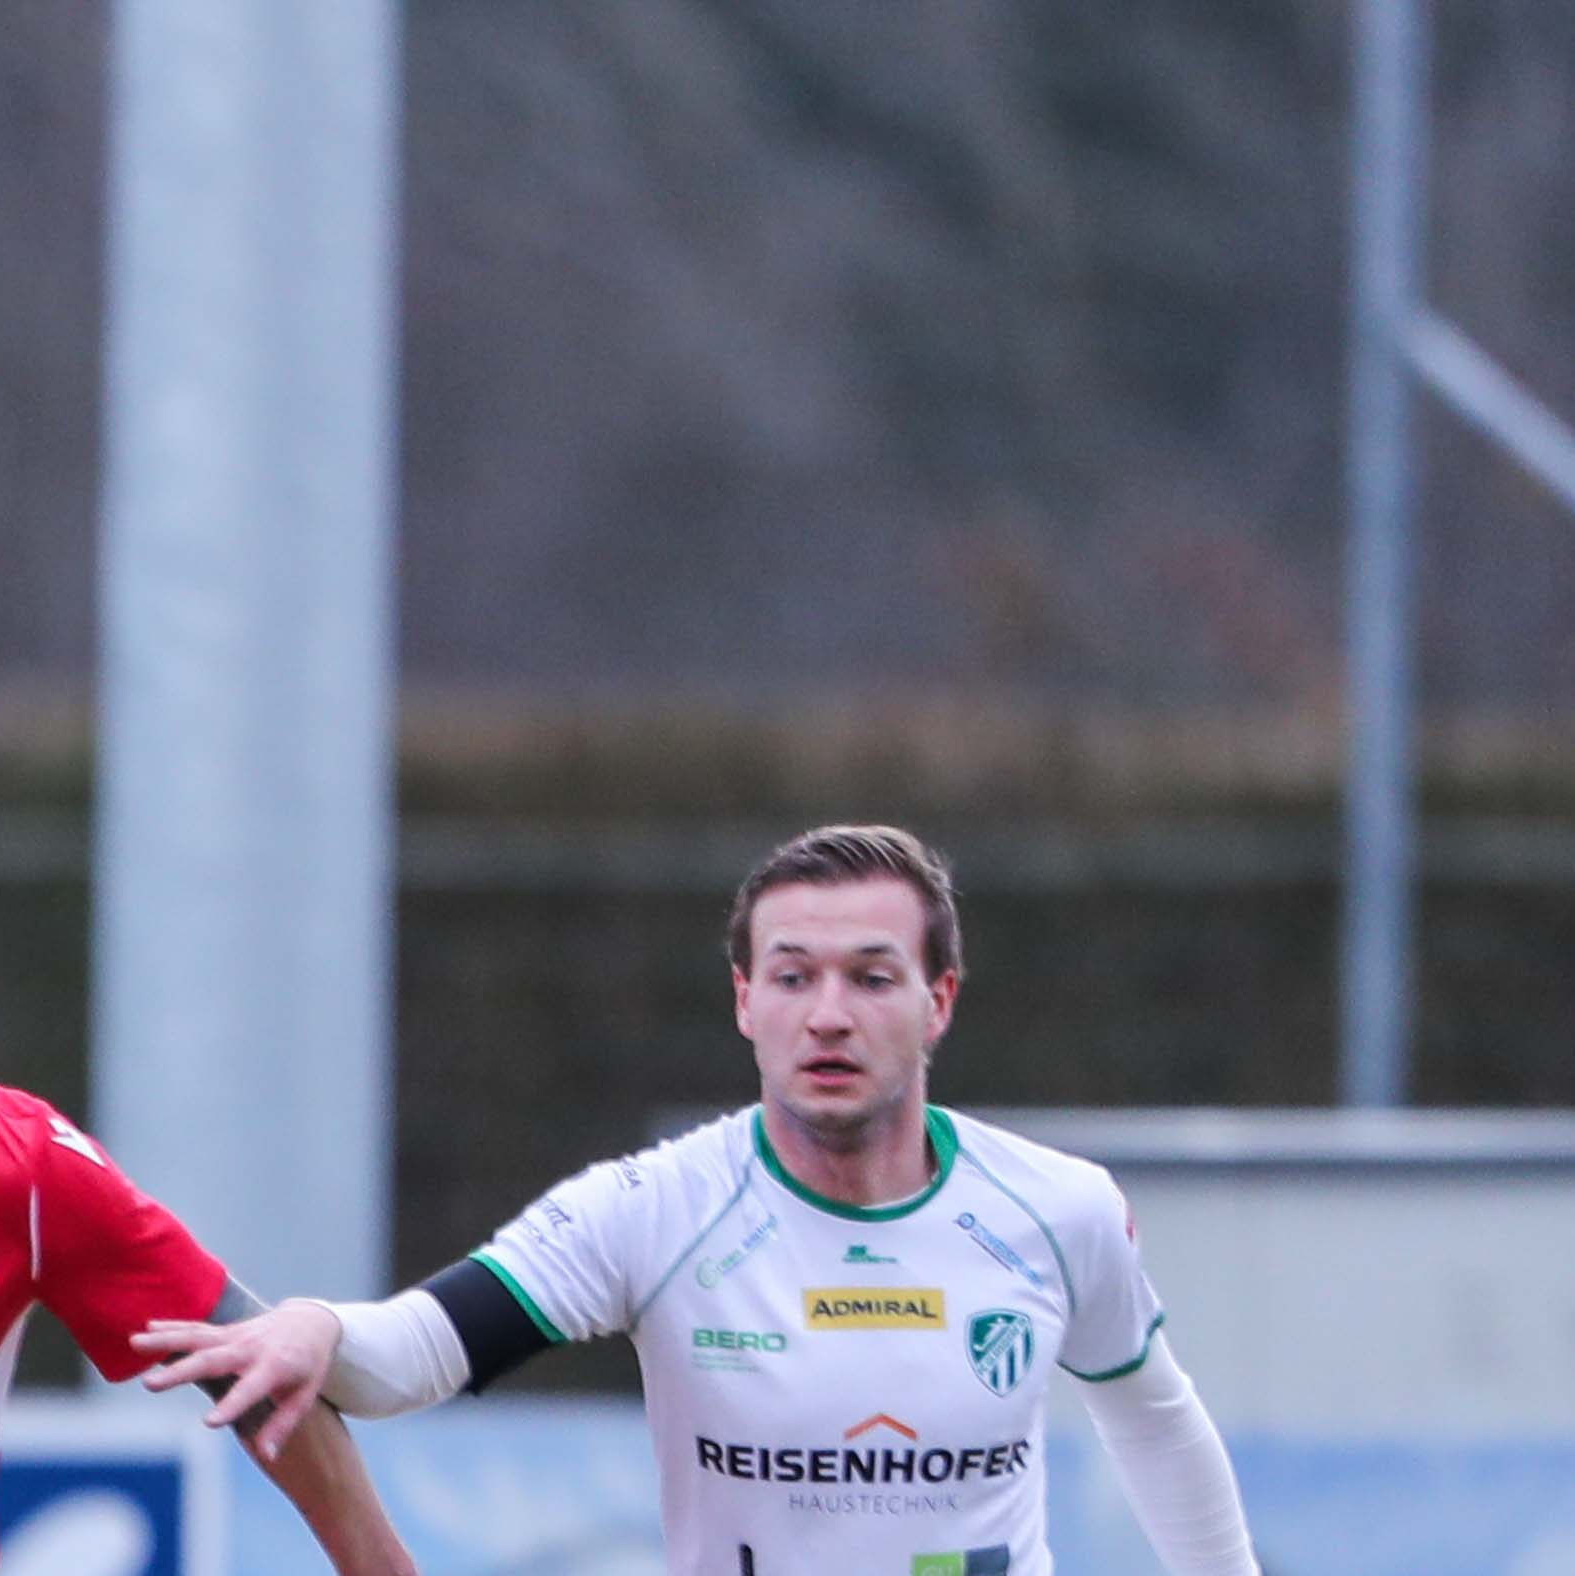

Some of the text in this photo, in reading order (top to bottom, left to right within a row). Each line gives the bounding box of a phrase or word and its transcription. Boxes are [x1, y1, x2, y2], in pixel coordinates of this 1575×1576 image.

[811, 1298, 938, 1320] ADMIRAL
[693, 1328, 788, 1353] BERO
[695, 1435, 1032, 1484] REISENHOFER
[789, 1493, 959, 1515] HAUSTECHNIK
